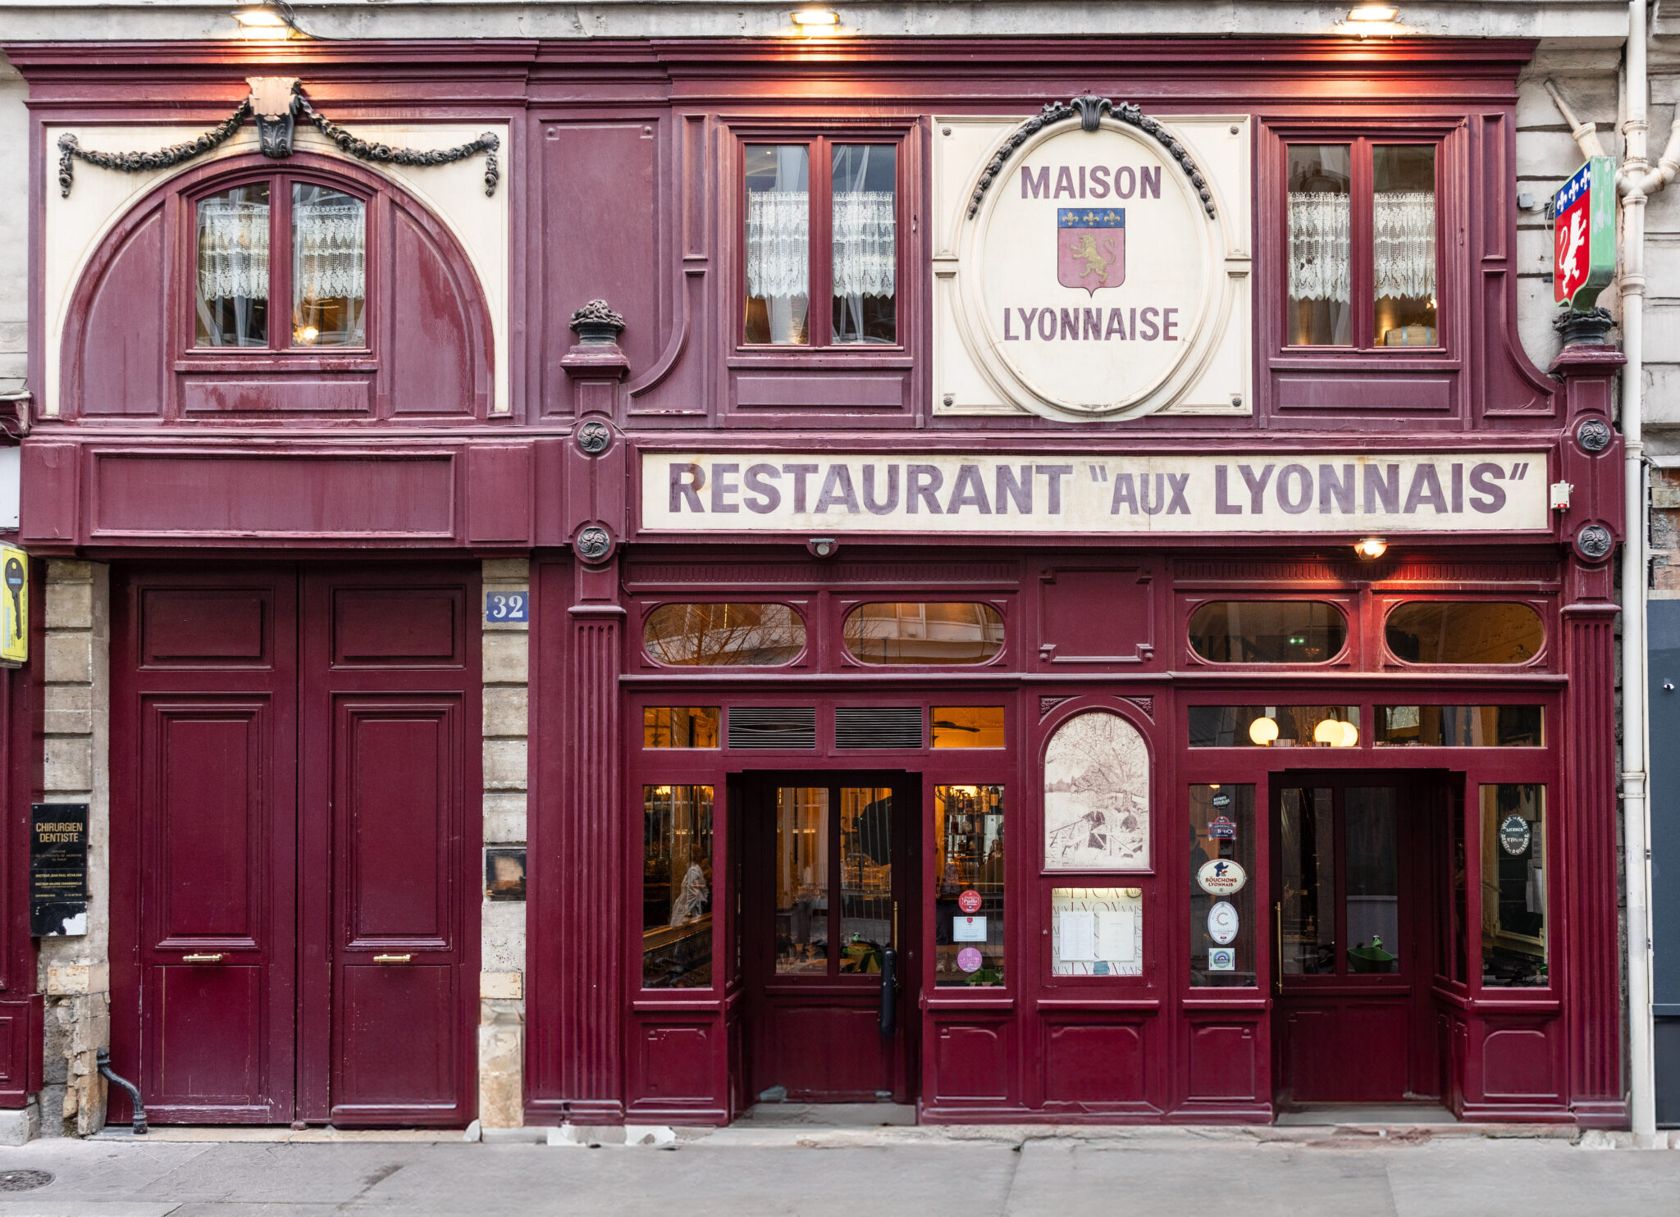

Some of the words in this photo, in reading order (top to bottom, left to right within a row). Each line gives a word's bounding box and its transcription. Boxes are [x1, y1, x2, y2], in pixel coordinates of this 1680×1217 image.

[1020, 165, 1162, 200] MAISON
[1003, 307, 1179, 342] LYONNAISE
[668, 462, 1074, 516] RESTAURANT
[493, 595, 523, 618] 32
[35, 822, 83, 832] CHIRURGIEN
[39, 833, 79, 843] DENTISTE
